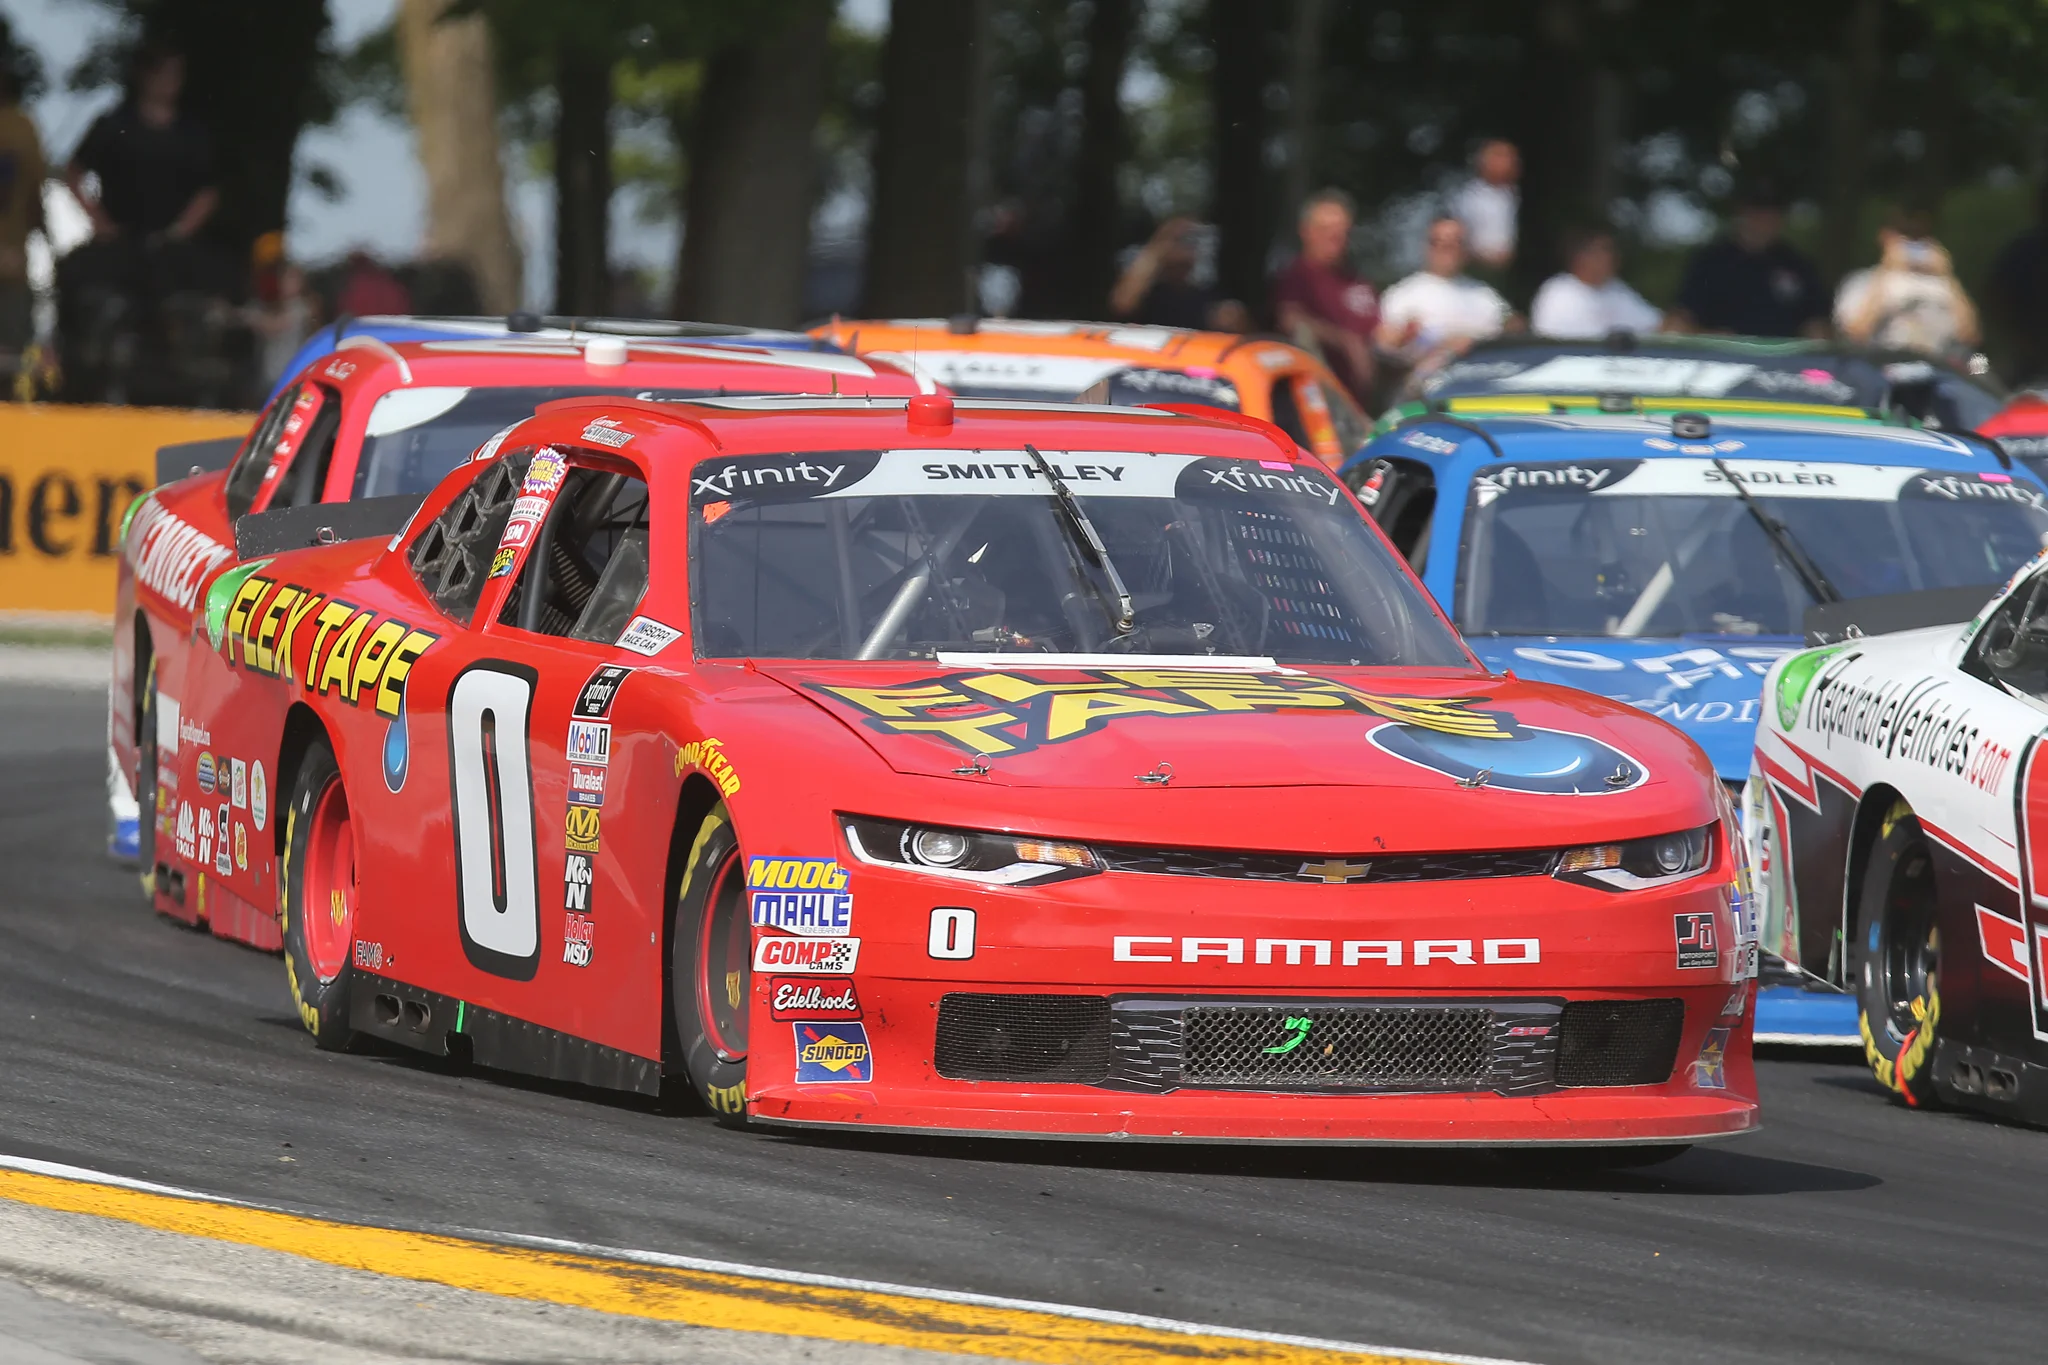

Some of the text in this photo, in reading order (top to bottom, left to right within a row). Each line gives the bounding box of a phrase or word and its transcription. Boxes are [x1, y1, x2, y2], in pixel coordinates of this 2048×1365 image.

[692, 461, 845, 496] xfinity
[922, 463, 1126, 482] SMITHLEY
[1203, 466, 1340, 505] xfinity
[1703, 468, 1837, 486] SADLER
[504, 523, 526, 542] SEM
[622, 633, 657, 651] RACE CAR
[637, 622, 671, 642] NASCAR
[226, 575, 440, 721] FLEX TAPE
[583, 678, 615, 708] xfinity
[569, 724, 609, 755] Mobil 1
[571, 767, 604, 791] Duralast
[674, 737, 741, 799] GOODYEAR
[450, 664, 538, 975] 0
[746, 859, 848, 890] MOOG
[753, 894, 850, 927] MAHLE
[564, 912, 595, 949] Holley
[929, 907, 976, 960] 0
[563, 941, 590, 968] MSD
[761, 941, 832, 965] COMP
[809, 961, 843, 970] CAMS
[1113, 935, 1542, 967] CAMARO
[773, 984, 857, 1011] Edelbrock
[804, 1045, 864, 1061] SUNOCO
